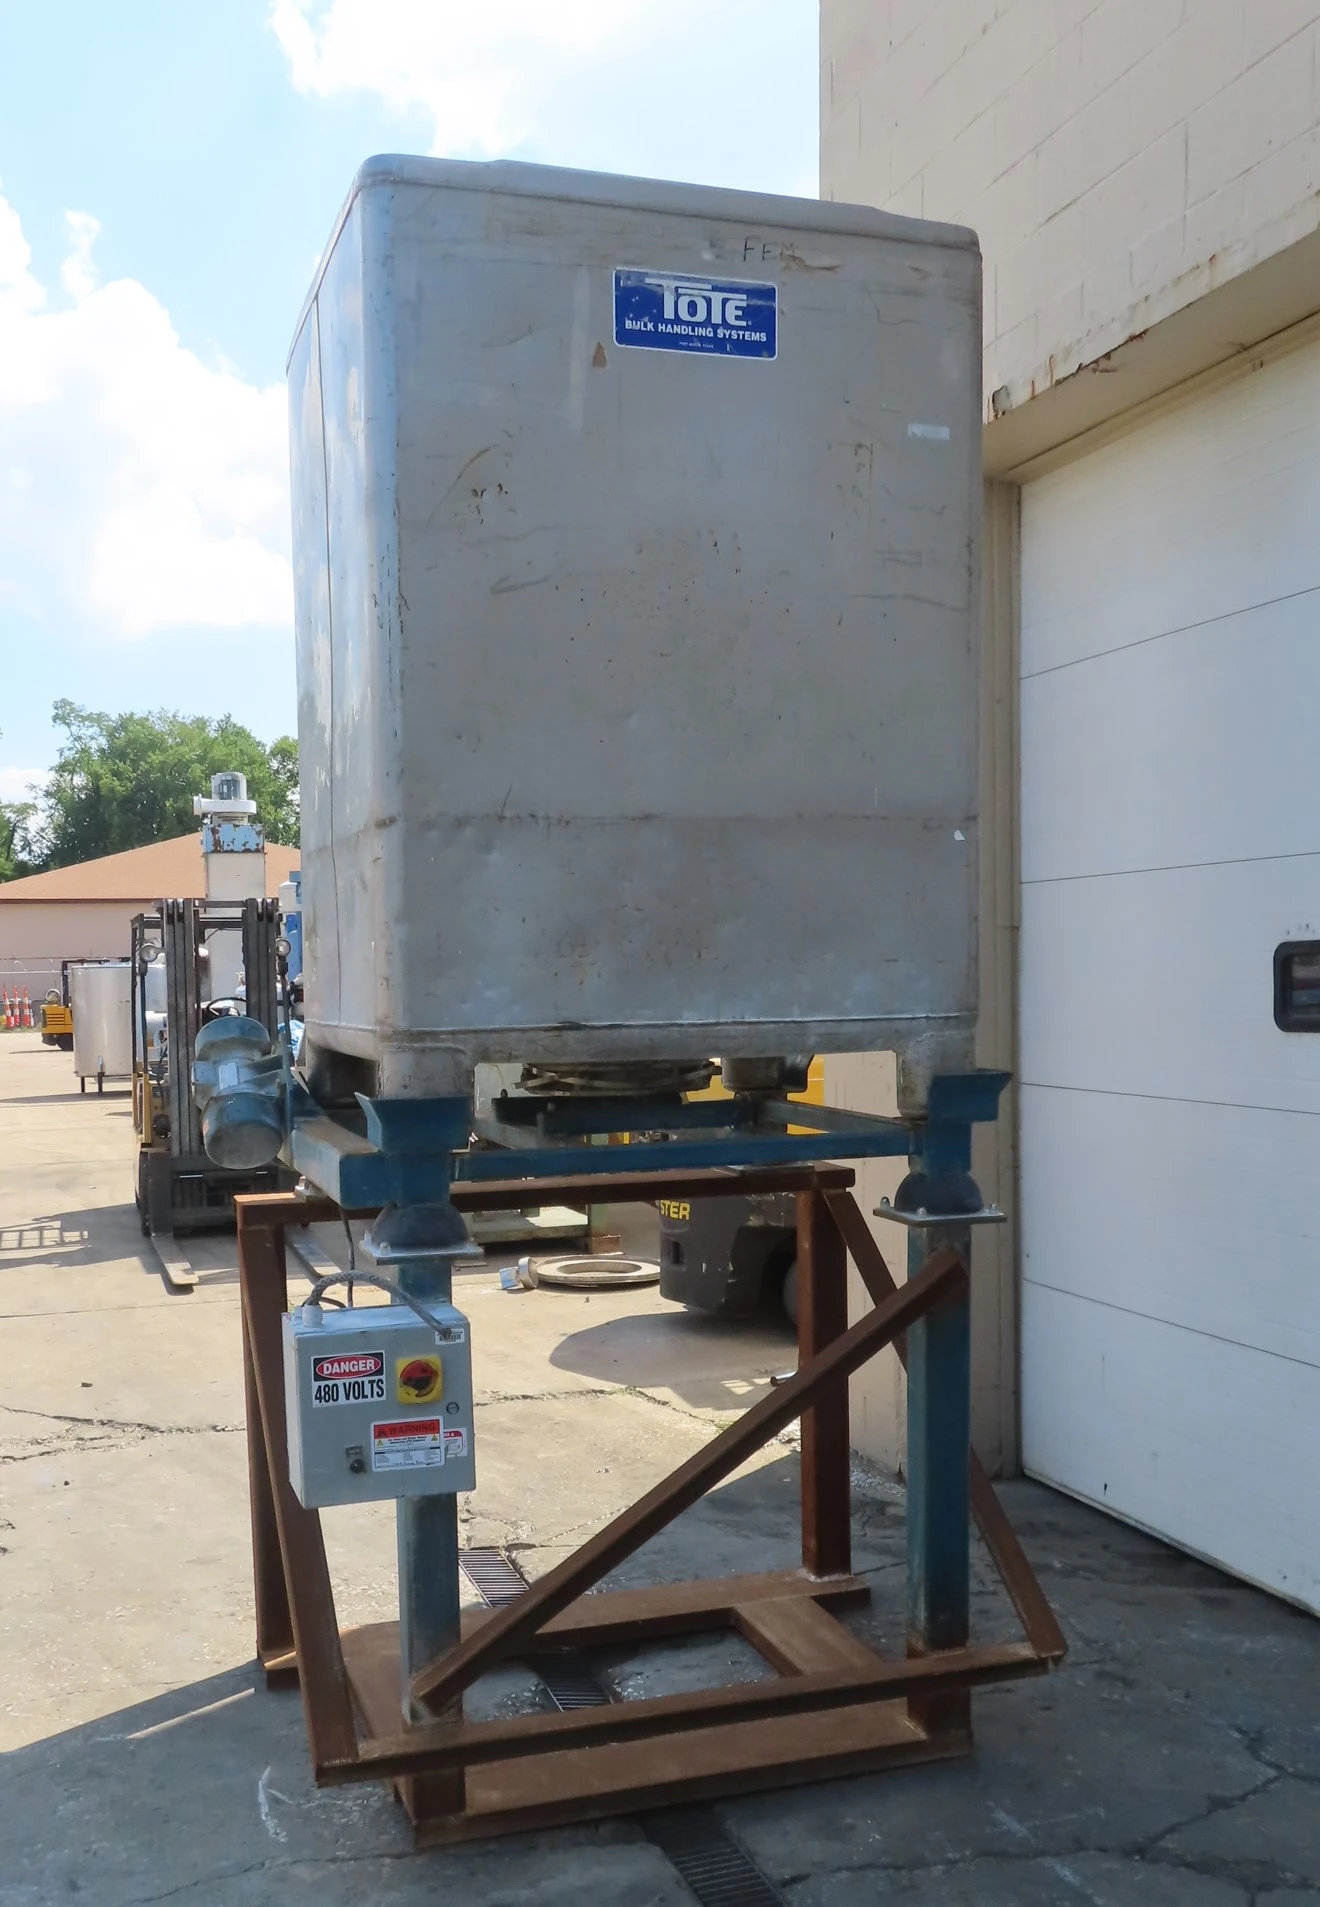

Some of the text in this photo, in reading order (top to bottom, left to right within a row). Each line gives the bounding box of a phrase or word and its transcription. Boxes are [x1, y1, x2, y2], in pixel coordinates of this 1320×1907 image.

[645, 277, 748, 327] TOTE
[625, 319, 767, 343] BULK HANDLING SYSTEMS
[655, 1199, 690, 1220] STER
[323, 1359, 375, 1375] DANGER
[314, 1378, 385, 1404] 480 VOLTS
[388, 1421, 436, 1435] WARNING
